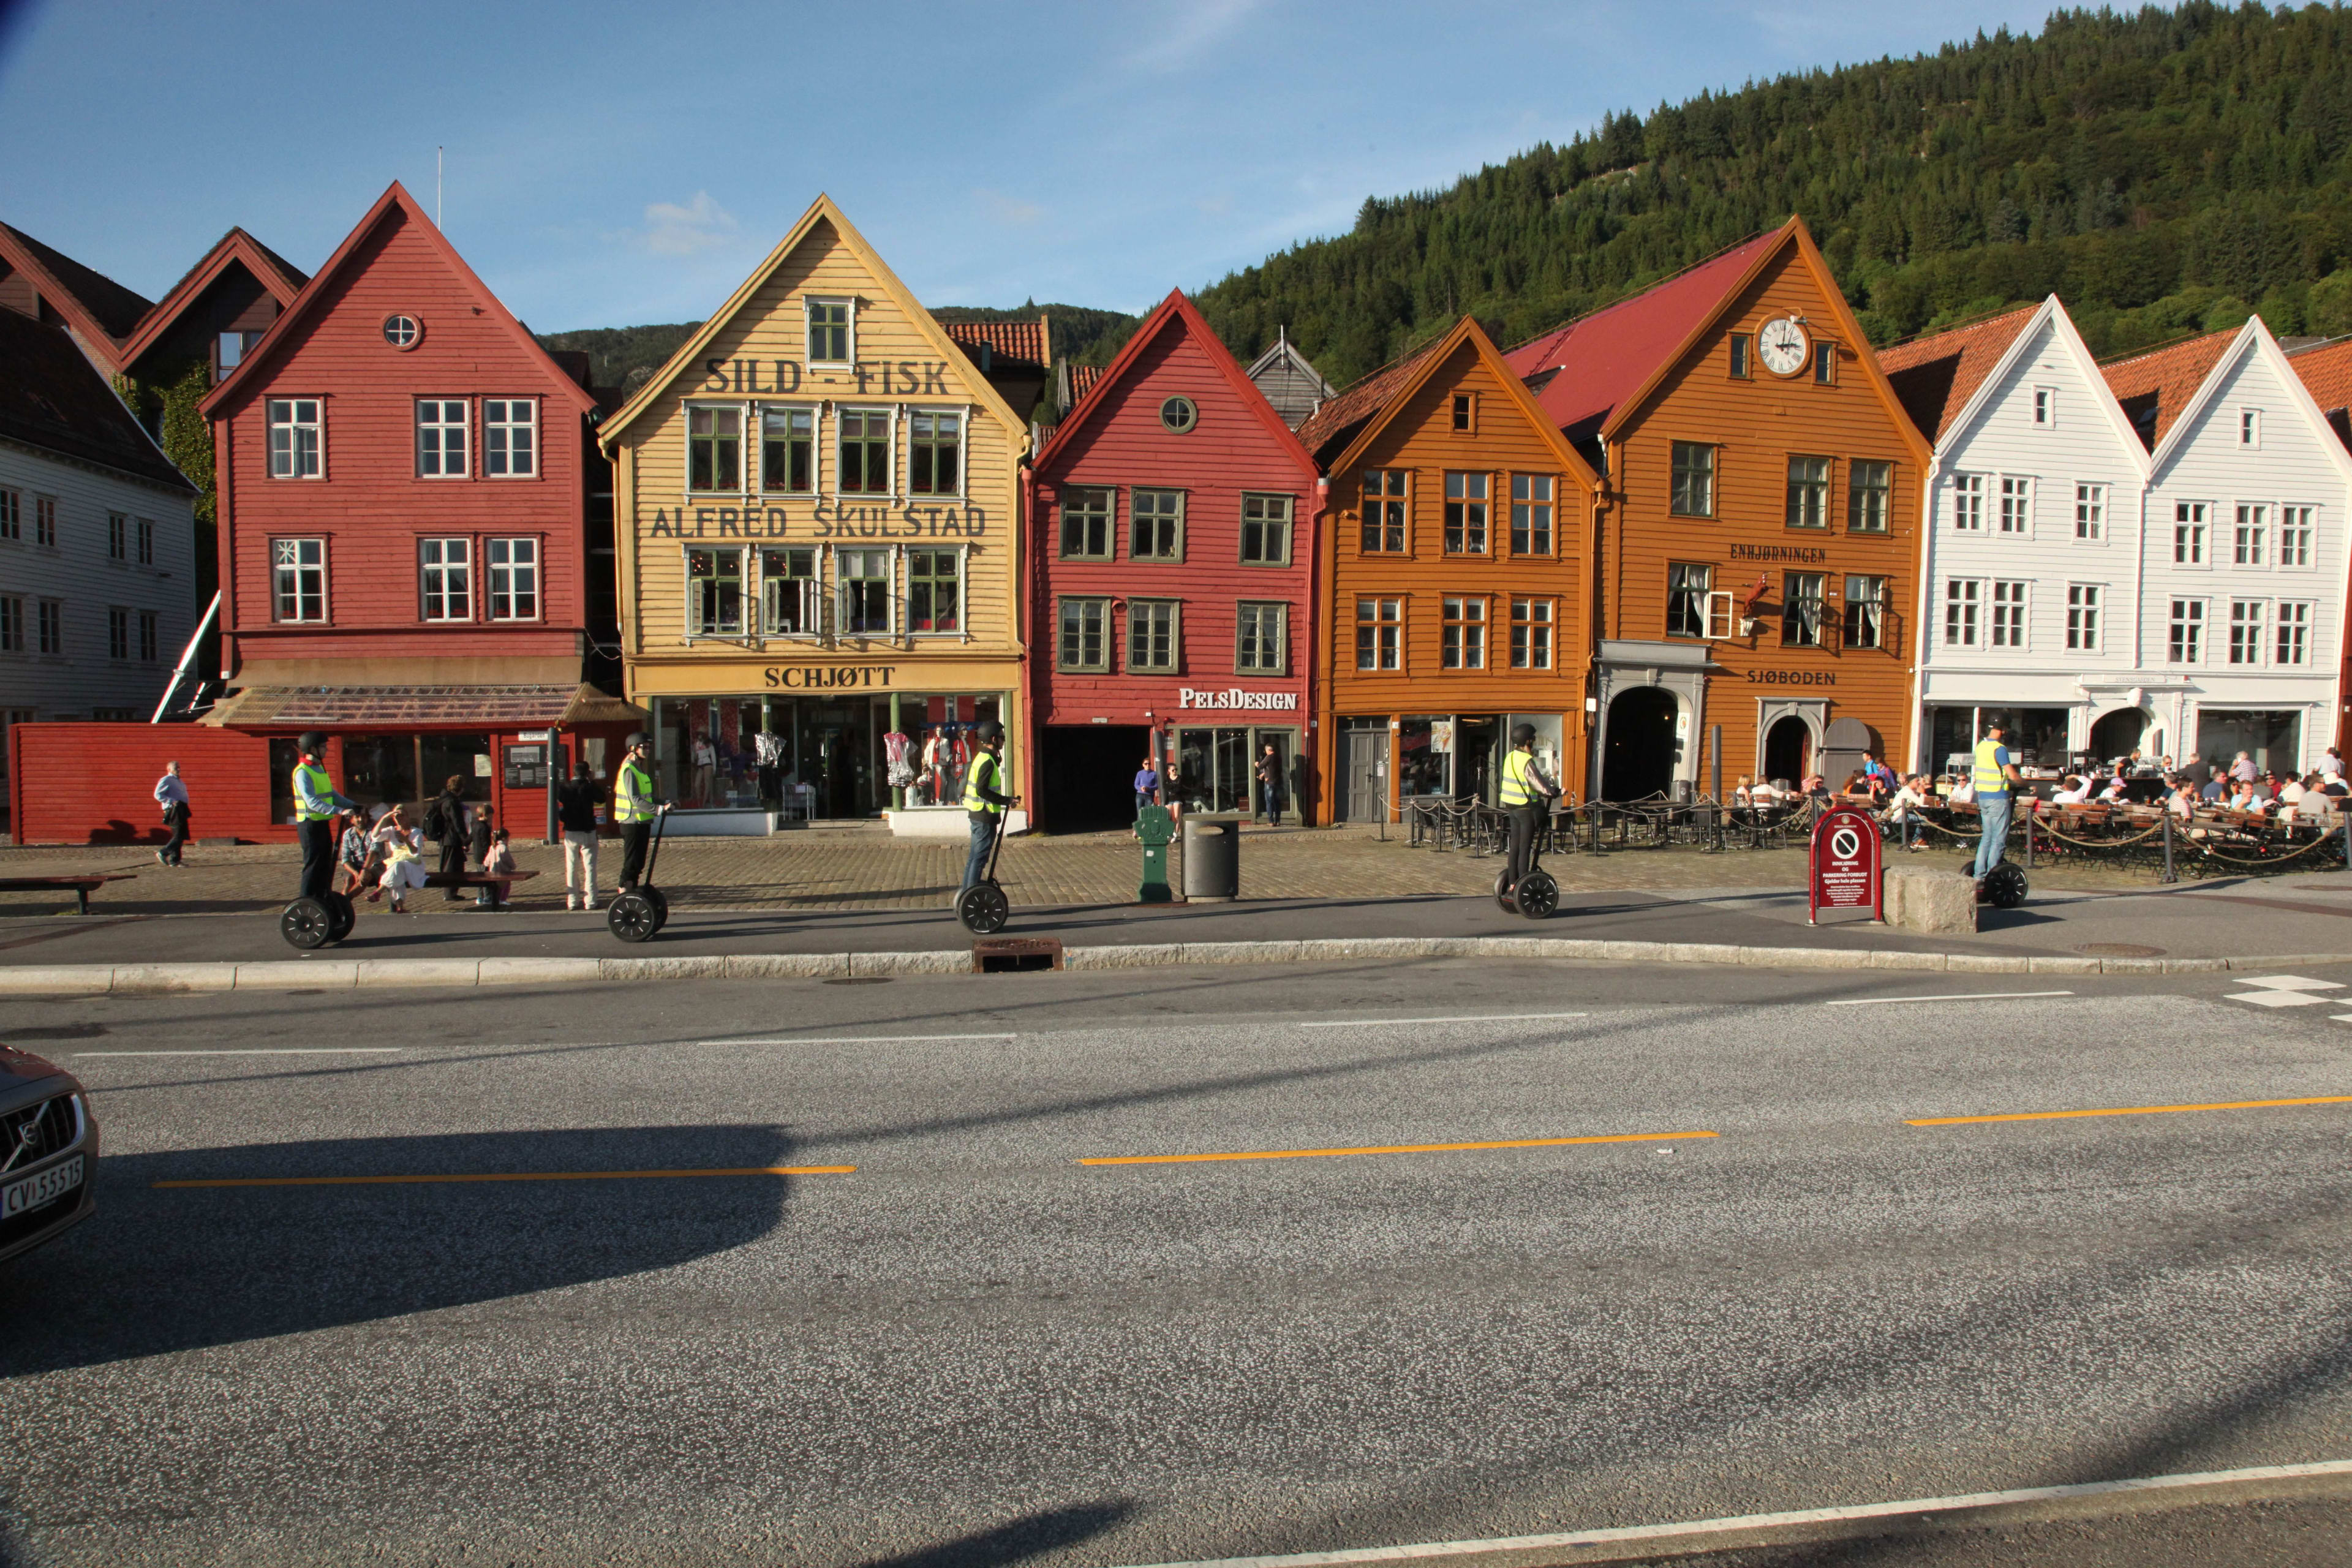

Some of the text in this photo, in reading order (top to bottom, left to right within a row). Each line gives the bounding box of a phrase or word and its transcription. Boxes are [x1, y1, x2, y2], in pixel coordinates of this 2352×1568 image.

[706, 358, 801, 393] SILD
[858, 360, 949, 394] FISK
[650, 507, 986, 538] ALFRED SKULSTAD
[764, 667, 895, 687] SCHJØTT
[1747, 670, 1835, 685] SJØBODEN
[9, 1160, 80, 1212] CV 55515
